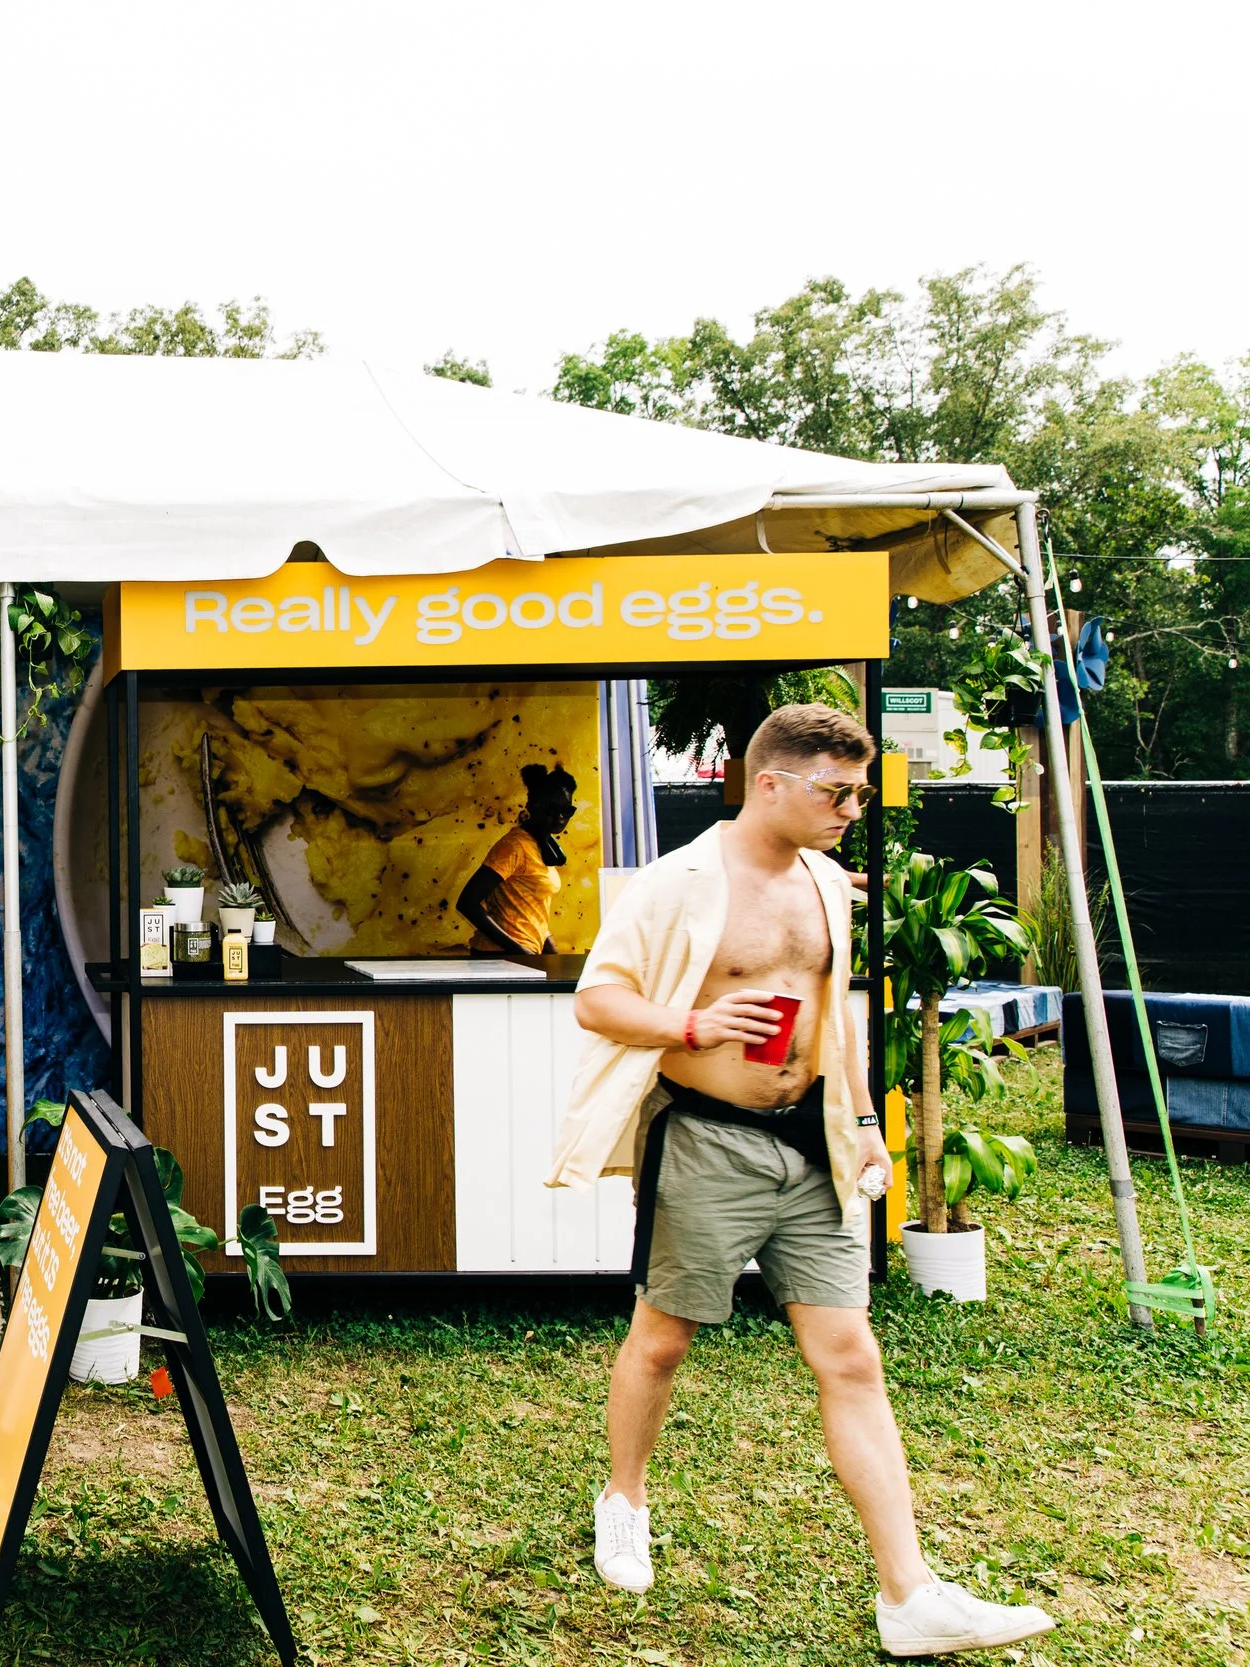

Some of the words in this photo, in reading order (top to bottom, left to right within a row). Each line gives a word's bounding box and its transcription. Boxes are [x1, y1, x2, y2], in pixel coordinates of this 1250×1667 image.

[184, 586, 399, 646] Really
[416, 581, 603, 645] good
[620, 581, 824, 640] eggs.
[67, 1144, 88, 1188] not
[259, 1185, 344, 1224] Egg
